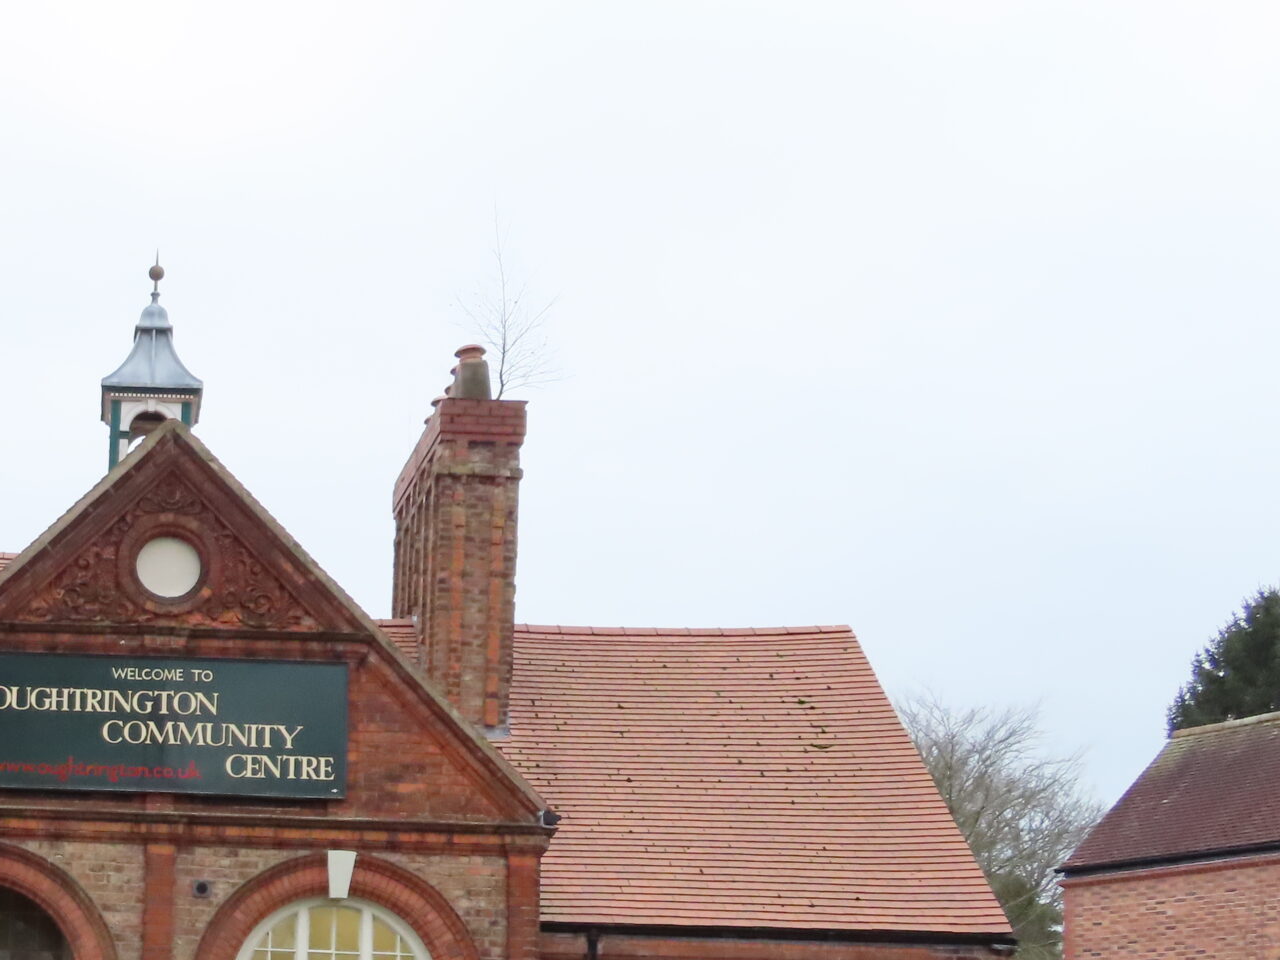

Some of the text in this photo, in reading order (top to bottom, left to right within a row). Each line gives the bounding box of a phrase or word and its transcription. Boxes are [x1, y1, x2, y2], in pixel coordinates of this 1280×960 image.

[111, 667, 214, 683] WELCOME TO
[102, 720, 304, 750] COMMUNITY
[225, 754, 335, 782] CENTRE
